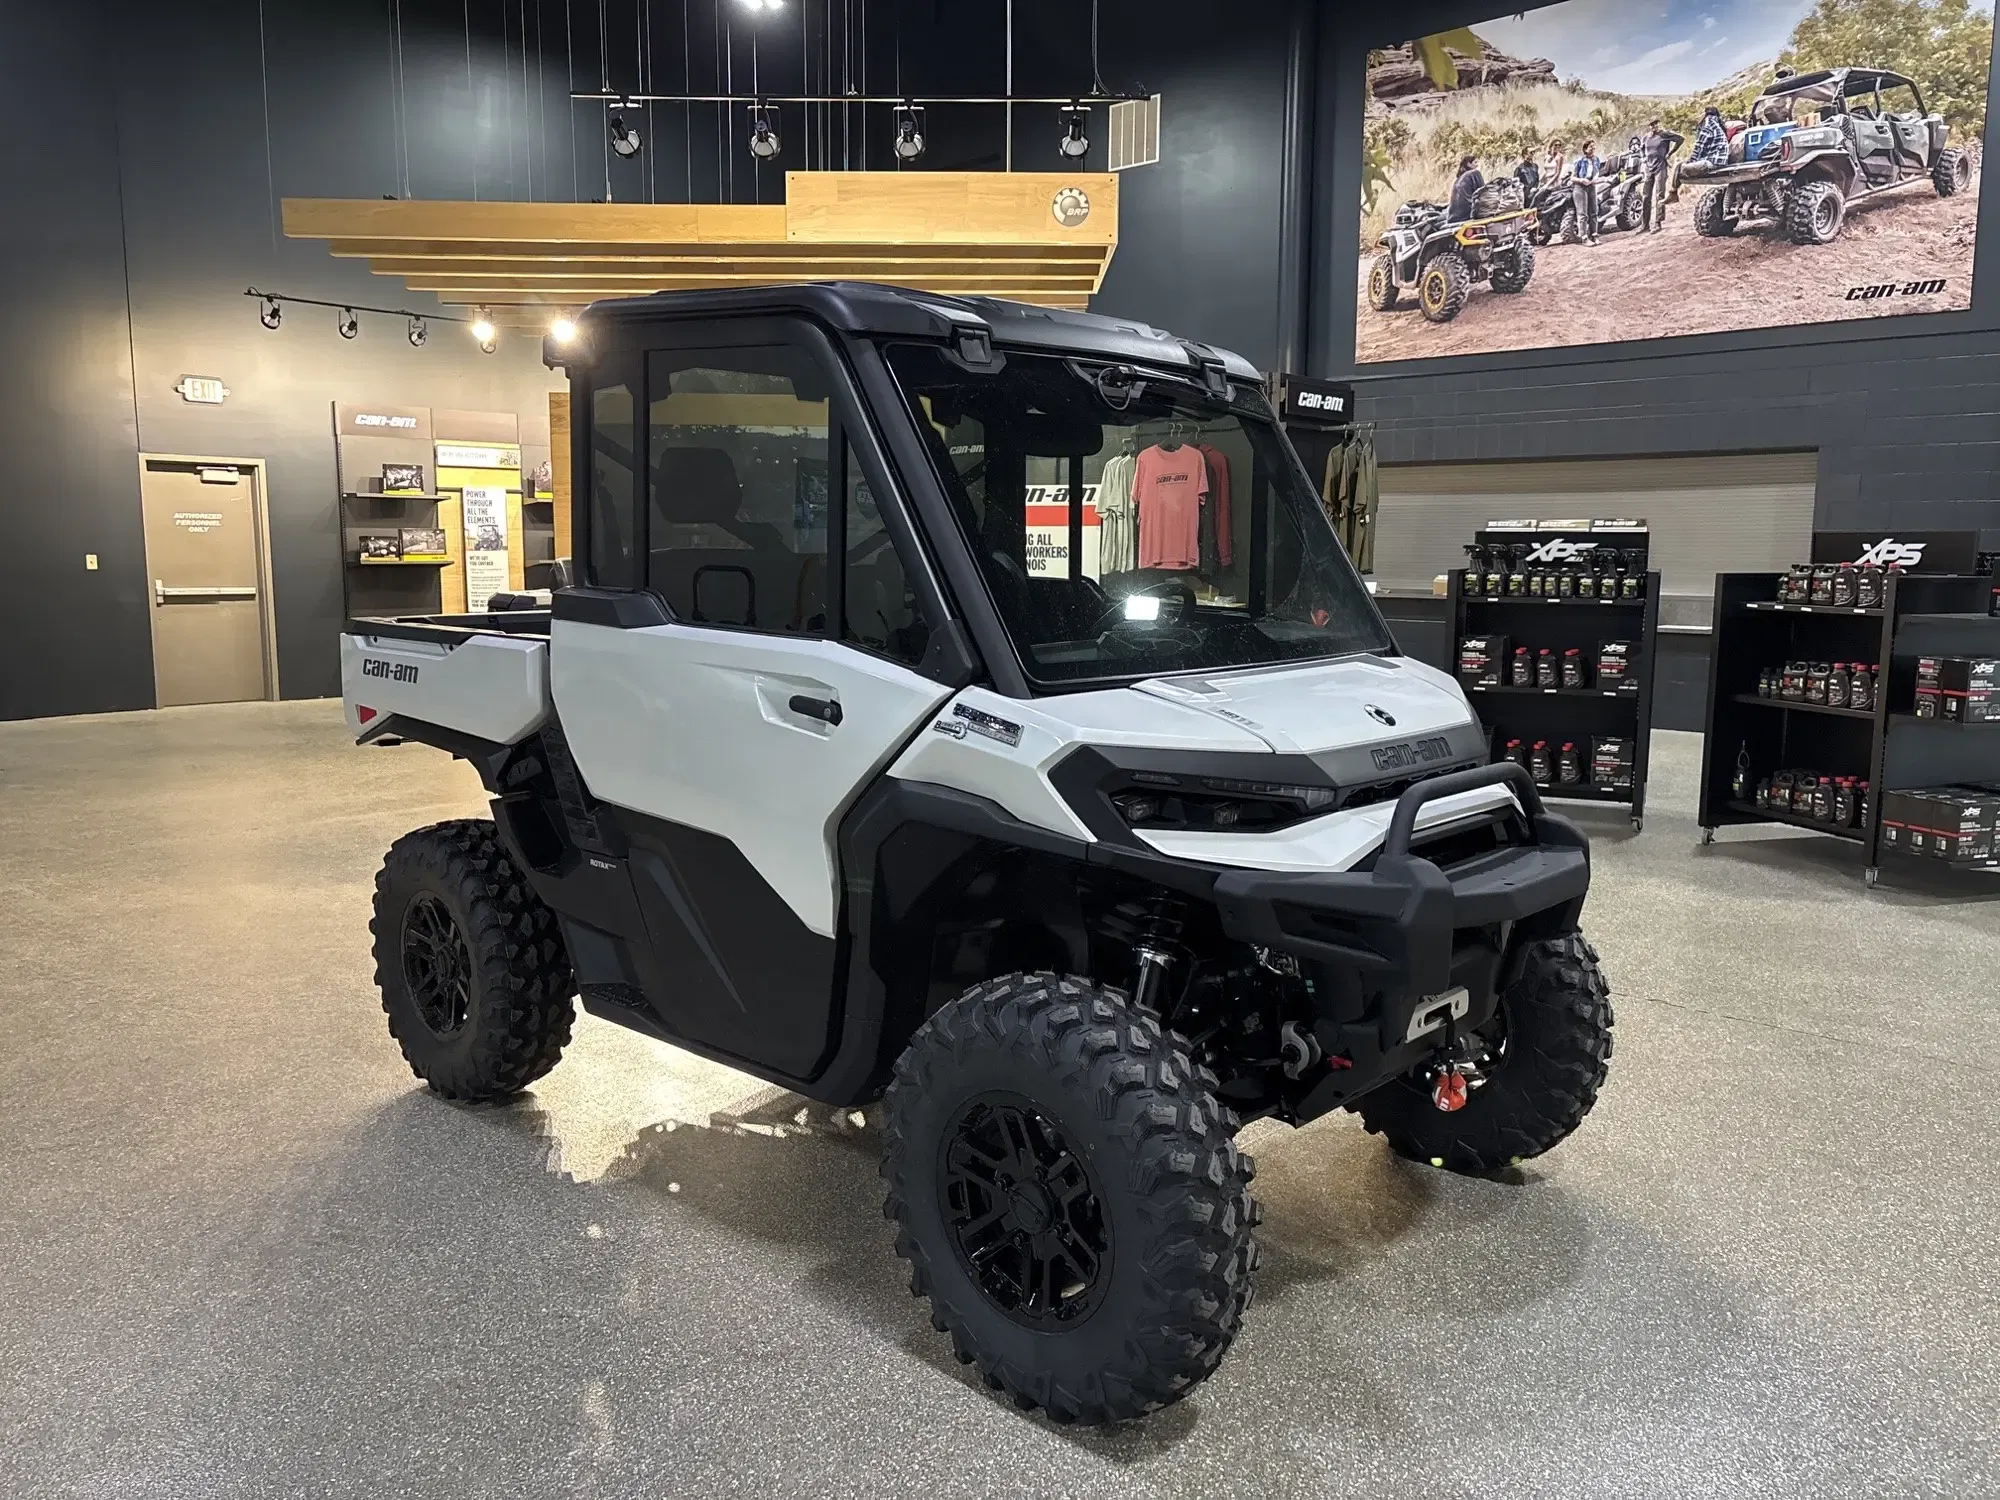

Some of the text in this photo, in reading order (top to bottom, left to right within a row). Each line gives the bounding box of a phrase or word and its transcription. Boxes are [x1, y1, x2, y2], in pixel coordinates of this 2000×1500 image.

[1066, 207, 1088, 216] BRP
[1844, 279, 1947, 301] can-am
[191, 380, 217, 400] EXIT
[1298, 391, 1344, 412] can-am
[354, 414, 417, 428] can-am
[1155, 473, 1189, 485] can-am
[465, 490, 486, 498] POWER
[466, 499, 493, 507] THROUGH
[173, 512, 223, 520] AUTHORIZED
[467, 507, 489, 516] ALL THE
[467, 516, 496, 524] ELEMENTS
[1036, 533, 1053, 546] ALL
[1525, 538, 1600, 562] XPS
[1852, 538, 1928, 566] XPS
[362, 658, 419, 684] can-am
[1972, 663, 1996, 674] XPS
[1370, 736, 1454, 772] can-am
